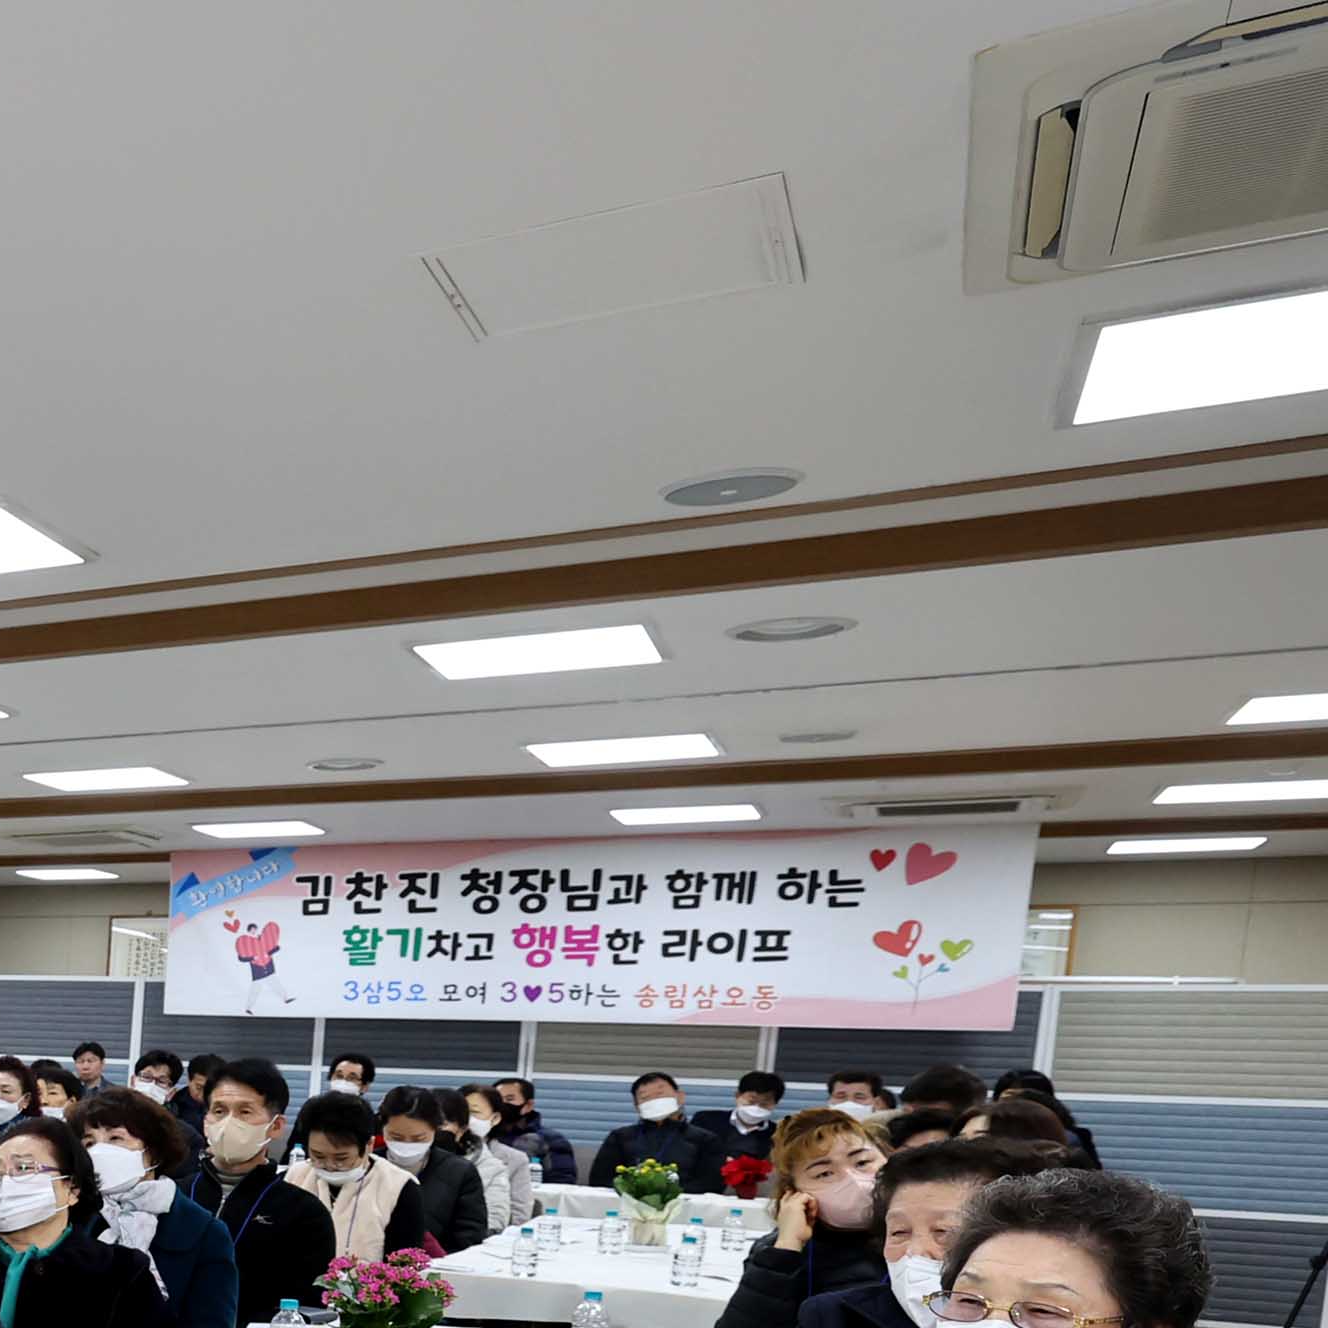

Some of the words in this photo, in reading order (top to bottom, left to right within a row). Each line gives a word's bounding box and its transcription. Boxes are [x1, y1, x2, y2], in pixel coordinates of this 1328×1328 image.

[295, 871, 441, 916] 김찬진
[460, 868, 648, 914] 청장님과
[665, 869, 758, 910] 함께
[776, 867, 866, 908] 하는
[343, 924, 495, 966] 활기차고
[511, 923, 645, 968] 행복한
[661, 929, 791, 963] 라이프
[343, 980, 428, 1005] 3삼5오
[439, 982, 487, 1005] 모여
[634, 984, 779, 1011] 송림삼오동
